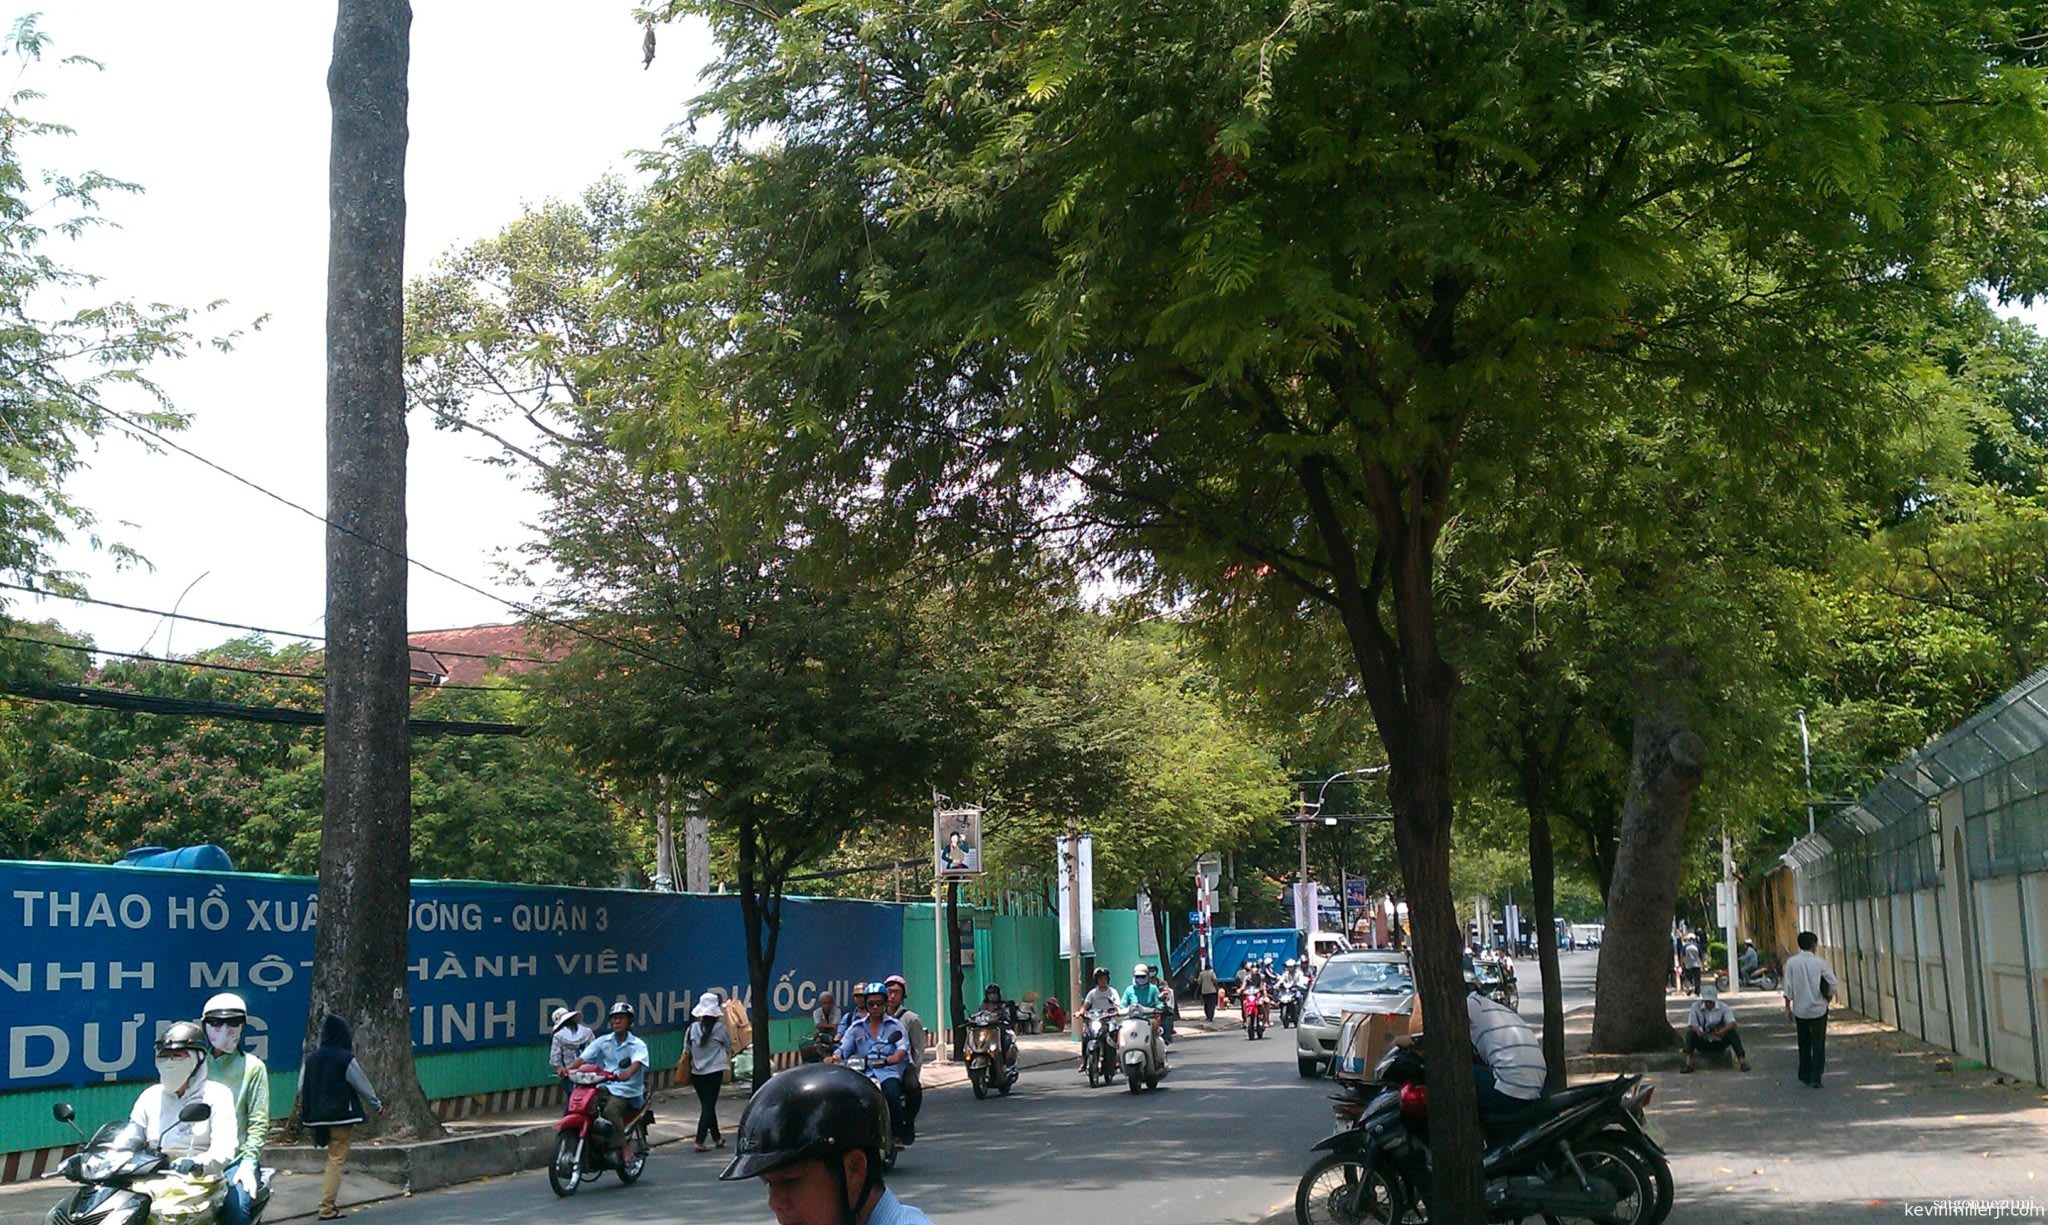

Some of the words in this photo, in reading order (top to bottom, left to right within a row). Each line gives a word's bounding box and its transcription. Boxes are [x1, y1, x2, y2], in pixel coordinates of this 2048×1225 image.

[13, 890, 152, 929] THAO
[168, 884, 230, 931] HỒ
[246, 893, 319, 932] XUÂ
[408, 899, 482, 932] ƠNG
[512, 899, 587, 936] QUẬN
[596, 907, 608, 932] 3
[189, 954, 314, 992] MỘ
[407, 951, 537, 980] HÀNH
[555, 948, 648, 975] VIÊN
[9, 1013, 269, 1081] DỰG
[409, 1000, 516, 1046] INH
[773, 969, 817, 1012] ỐC
